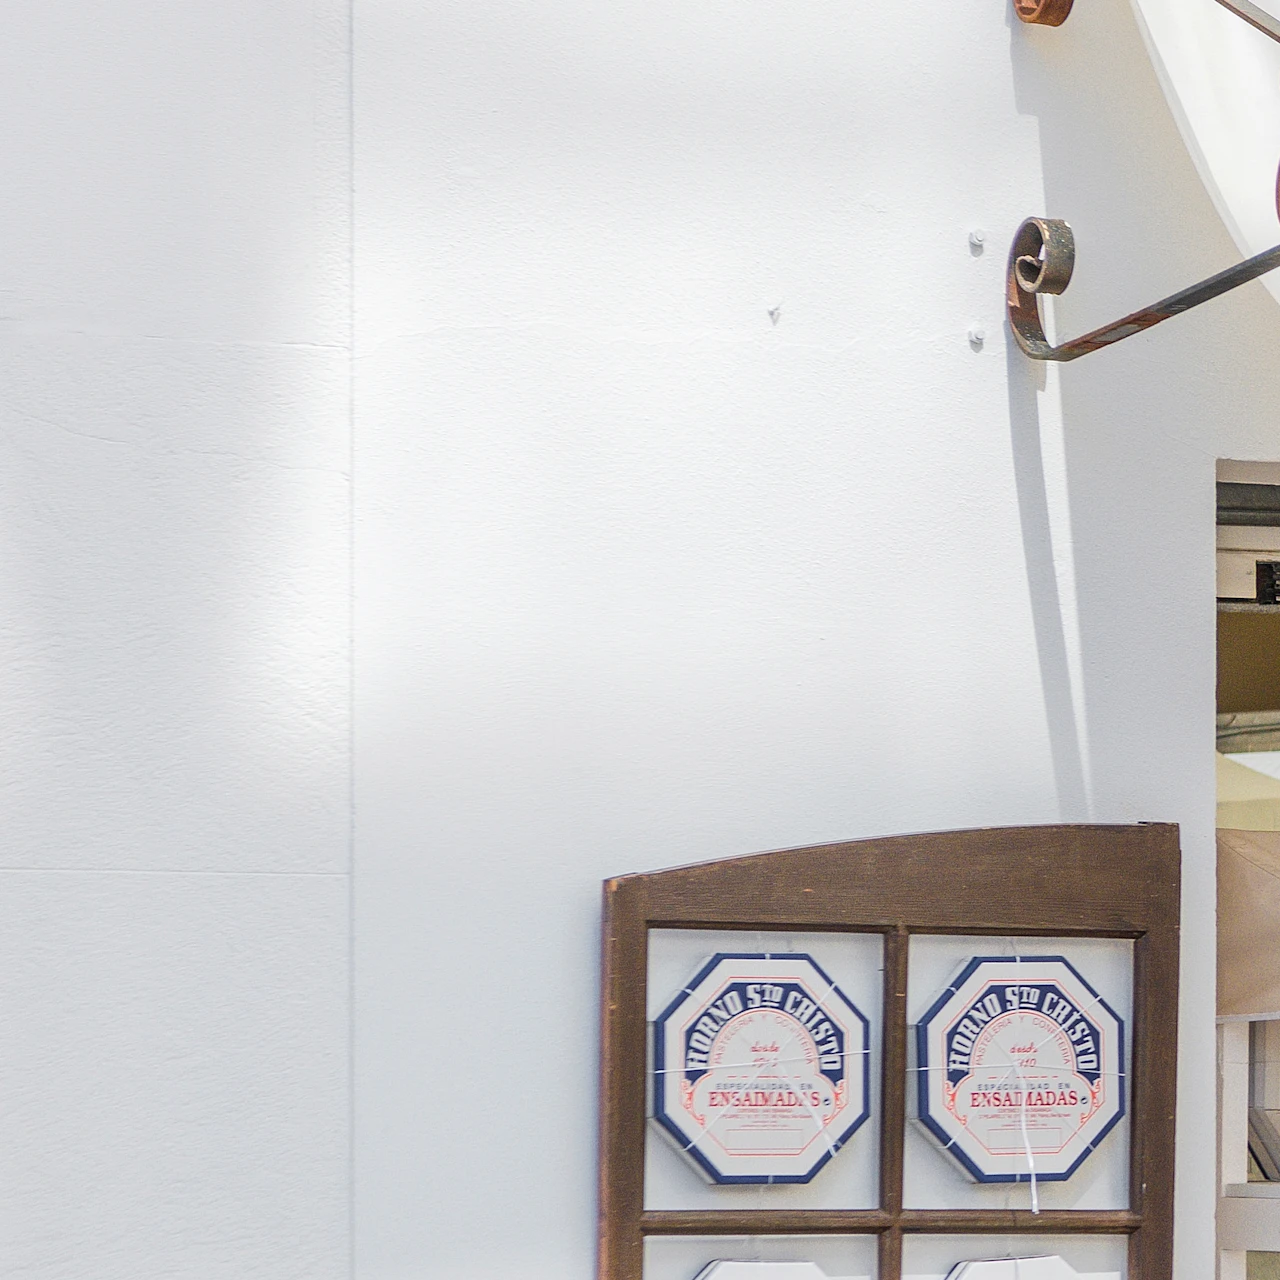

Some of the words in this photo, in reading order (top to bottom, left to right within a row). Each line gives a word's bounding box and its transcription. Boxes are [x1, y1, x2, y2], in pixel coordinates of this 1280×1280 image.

[687, 991, 743, 1070] HORNO
[784, 991, 842, 1070] CRISTO
[949, 993, 1002, 1072] HORNO
[1041, 992, 1098, 1070] CRISTO
[977, 1083, 1050, 1091] ESPECIAIDAD
